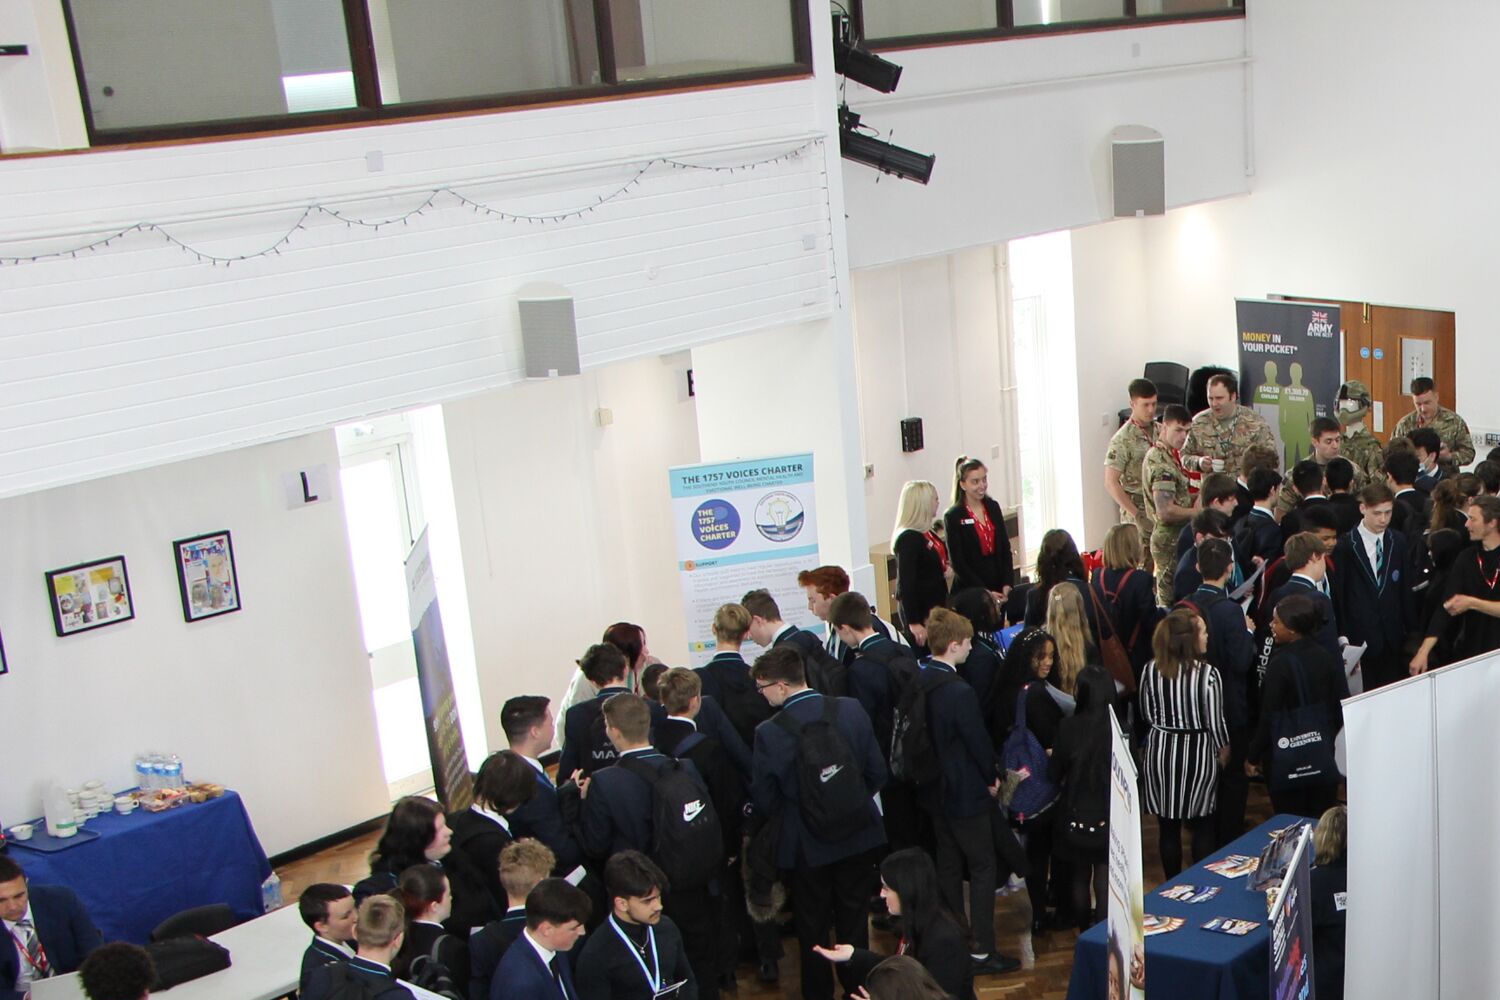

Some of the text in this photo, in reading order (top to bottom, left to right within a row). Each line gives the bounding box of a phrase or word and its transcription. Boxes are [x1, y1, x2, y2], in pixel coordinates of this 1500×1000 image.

[1307, 322, 1333, 333] ARMY
[1242, 332, 1281, 343] MONEY IN
[1242, 342, 1265, 352] YOUR
[682, 464, 804, 485] THE 1757 VOICES CHARTER
[299, 471, 318, 503] L
[698, 509, 713, 517] THE
[698, 517, 716, 525] 1757
[700, 531, 737, 542] CHARTER
[1290, 731, 1318, 742] UNIVERSITY
[1290, 735, 1322, 748] GREENWICH
[592, 751, 615, 760] MA
[684, 800, 702, 813] NIKE
